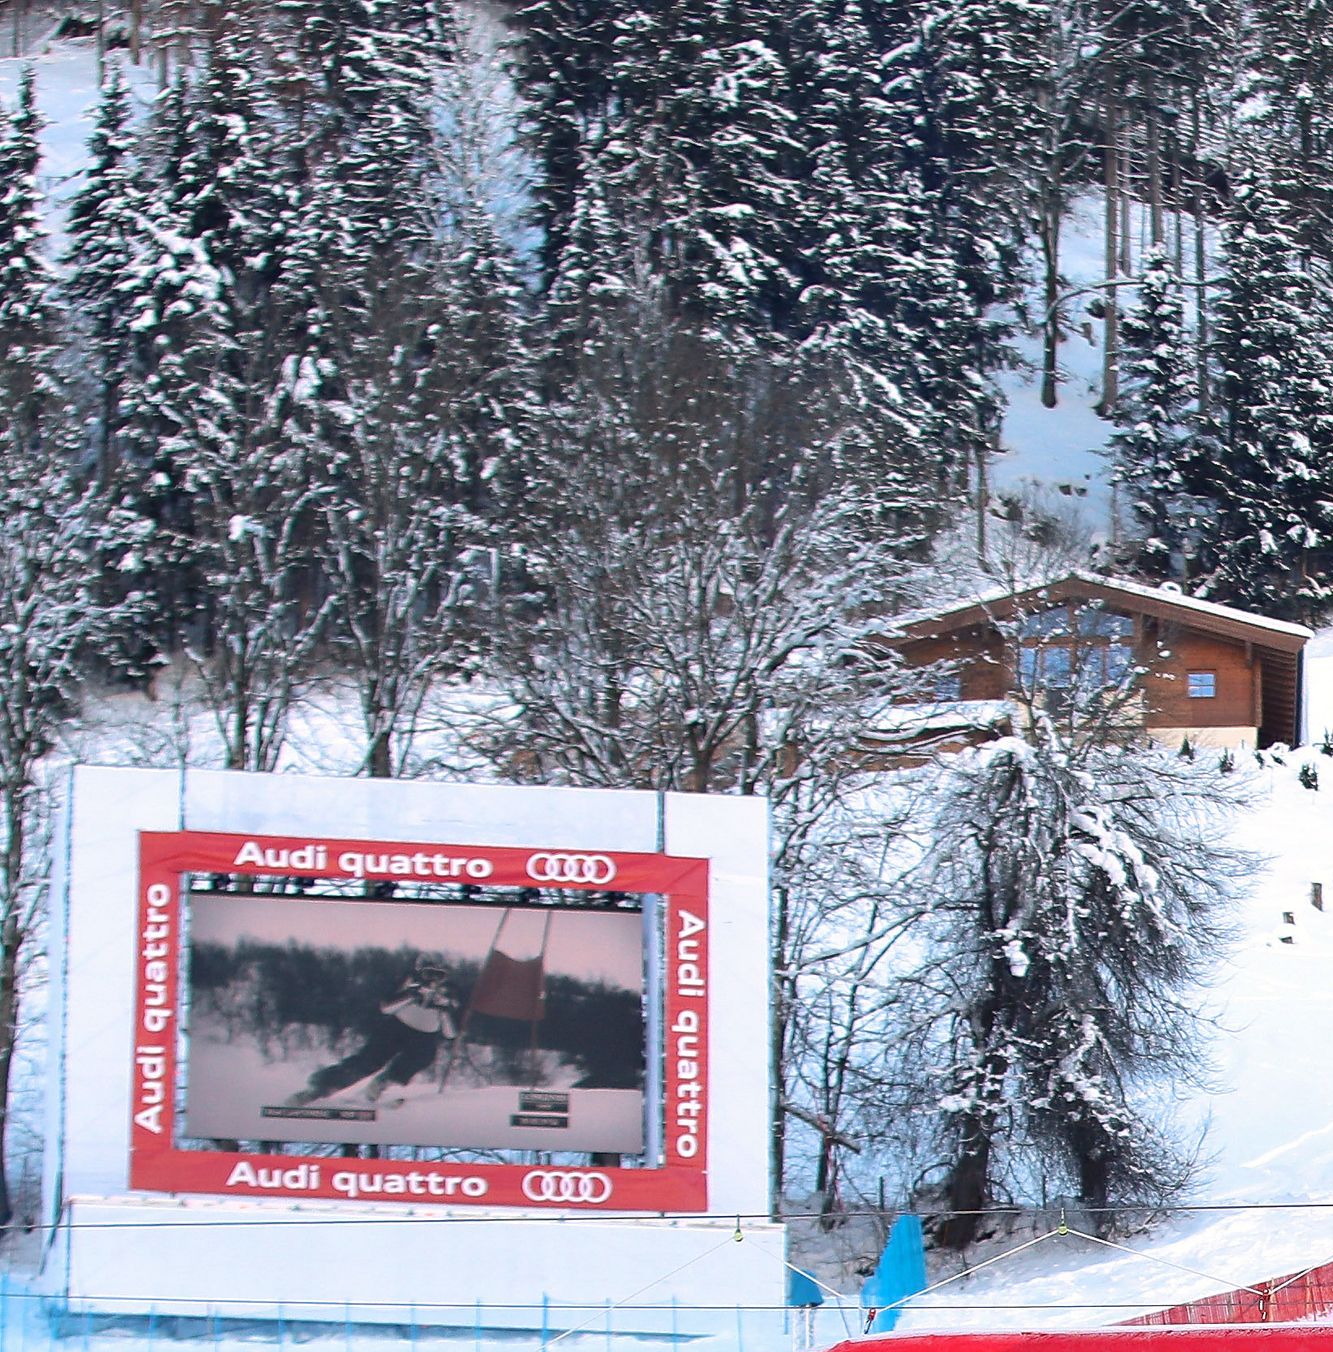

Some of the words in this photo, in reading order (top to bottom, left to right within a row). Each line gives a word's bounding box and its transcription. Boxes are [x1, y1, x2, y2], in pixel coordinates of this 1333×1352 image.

[233, 841, 327, 871] Audi
[338, 851, 493, 878] quattro
[142, 883, 172, 1032] quattro
[677, 909, 706, 997] Audi
[134, 1046, 165, 1134] Audi
[671, 1010, 702, 1158] quattro
[226, 1161, 320, 1190] Audi
[332, 1172, 488, 1198] quattro
